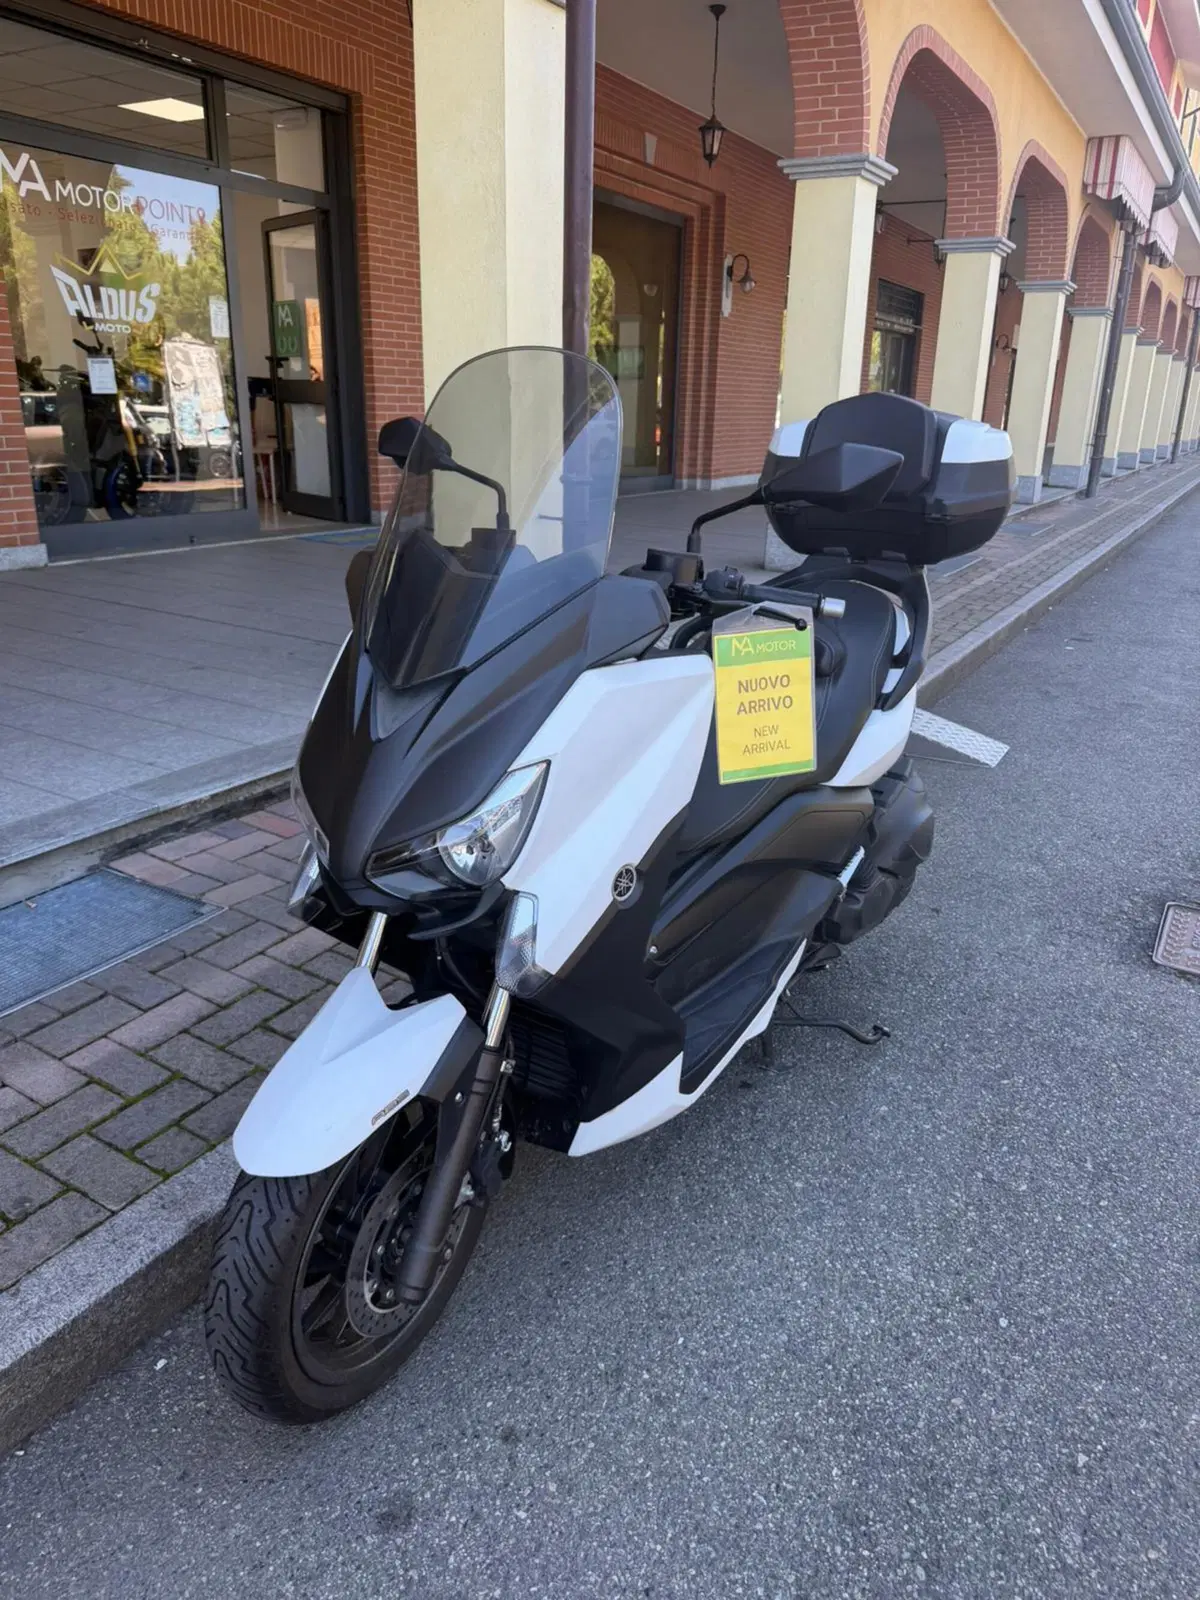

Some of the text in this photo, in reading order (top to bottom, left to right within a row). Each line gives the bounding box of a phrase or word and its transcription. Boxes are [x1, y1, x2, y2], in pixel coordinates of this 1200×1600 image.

[50, 265, 161, 323] ALDUS
[94, 322, 132, 334] MOTO
[756, 639, 796, 654] MOTOR
[738, 674, 791, 694] NUOVO
[737, 695, 793, 716] ARRIVO
[753, 724, 779, 738] NEW
[742, 739, 791, 756] ARRIVAL
